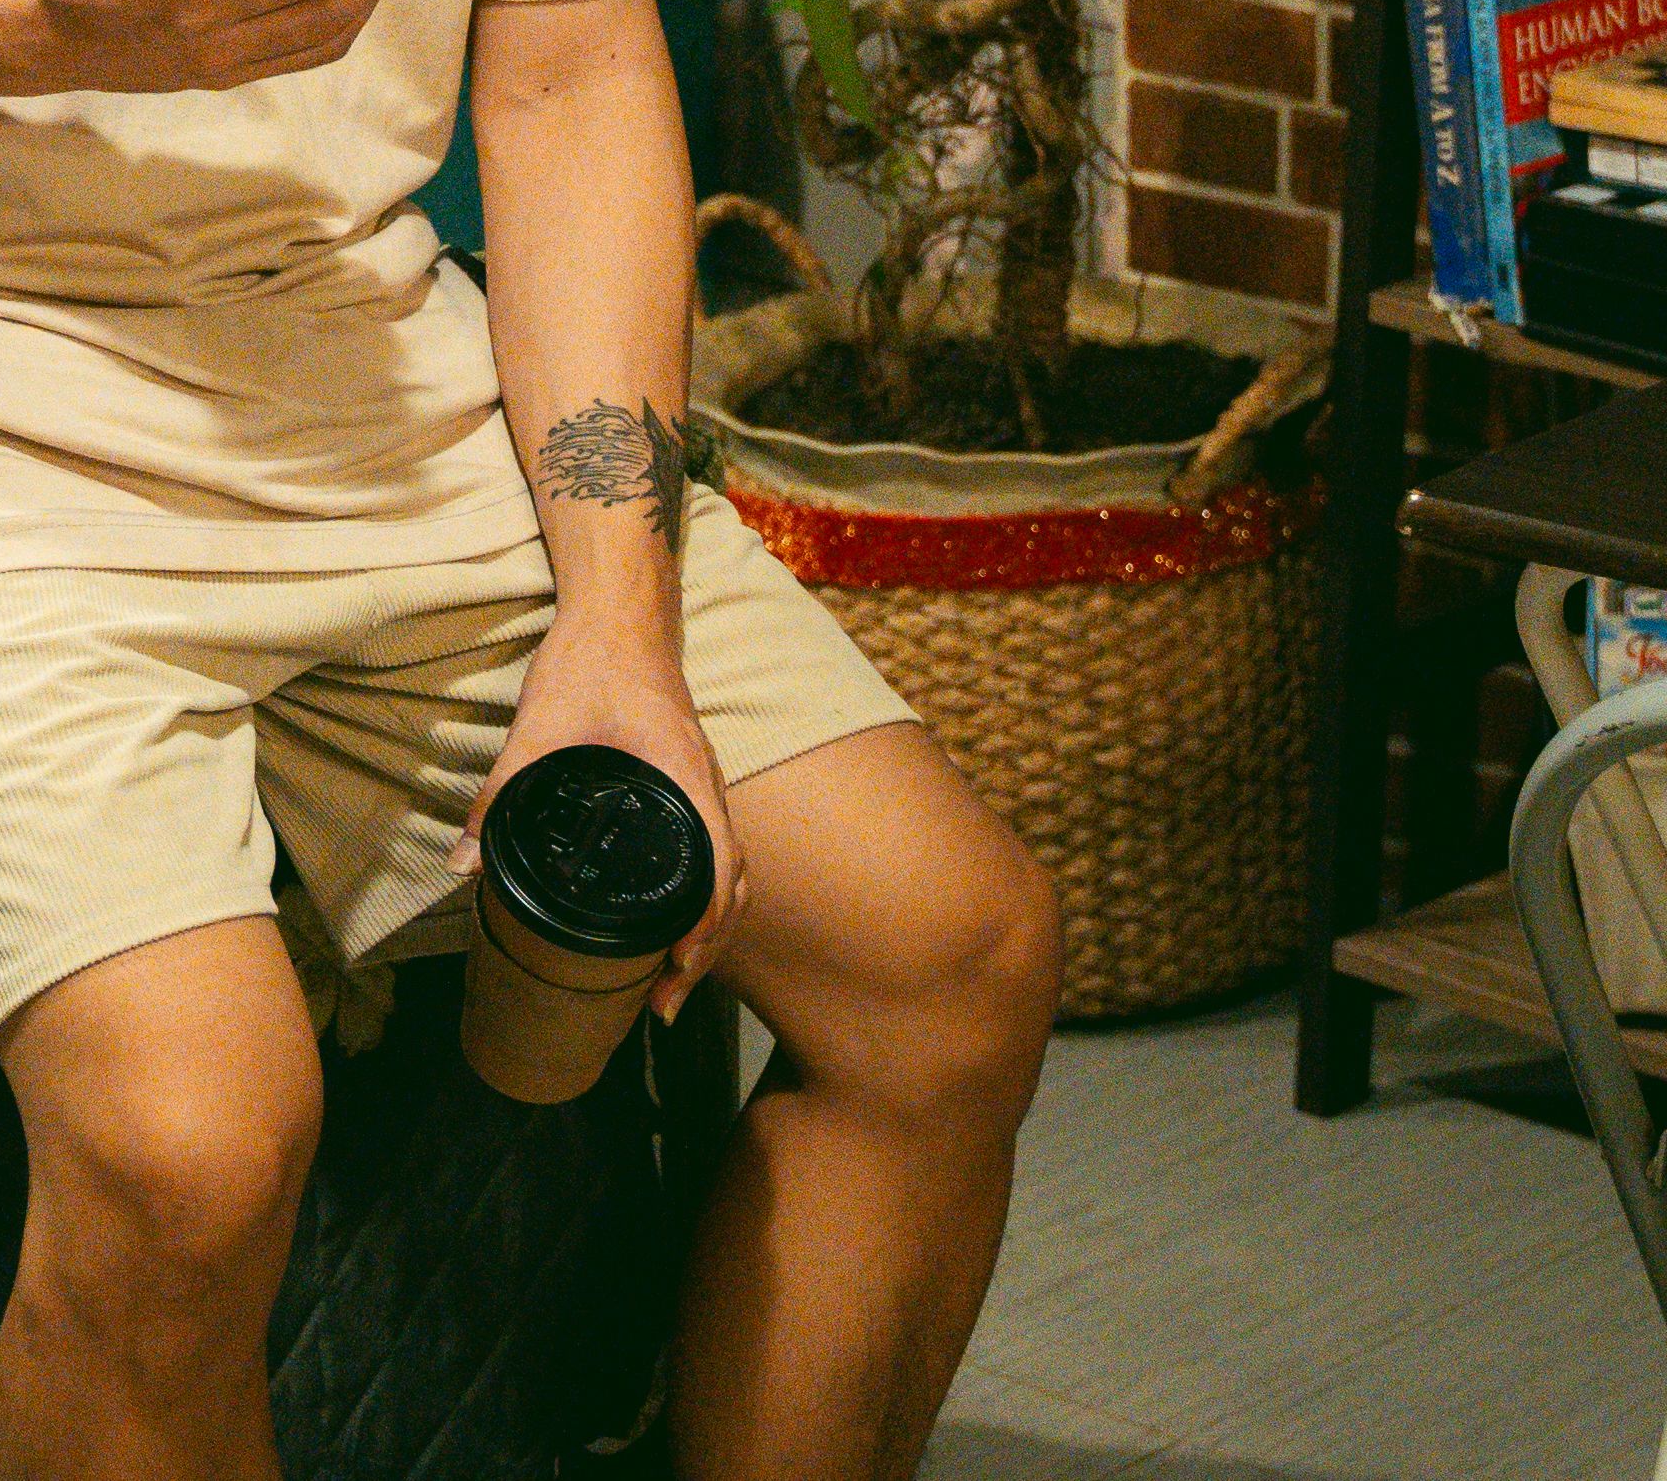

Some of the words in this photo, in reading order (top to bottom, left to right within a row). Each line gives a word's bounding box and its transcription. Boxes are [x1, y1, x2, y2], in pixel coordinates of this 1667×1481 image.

[1425, 23, 1451, 96] FROM
[1428, 99, 1456, 123] A
[1436, 129, 1454, 161] TO
[1436, 164, 1461, 188] Z
